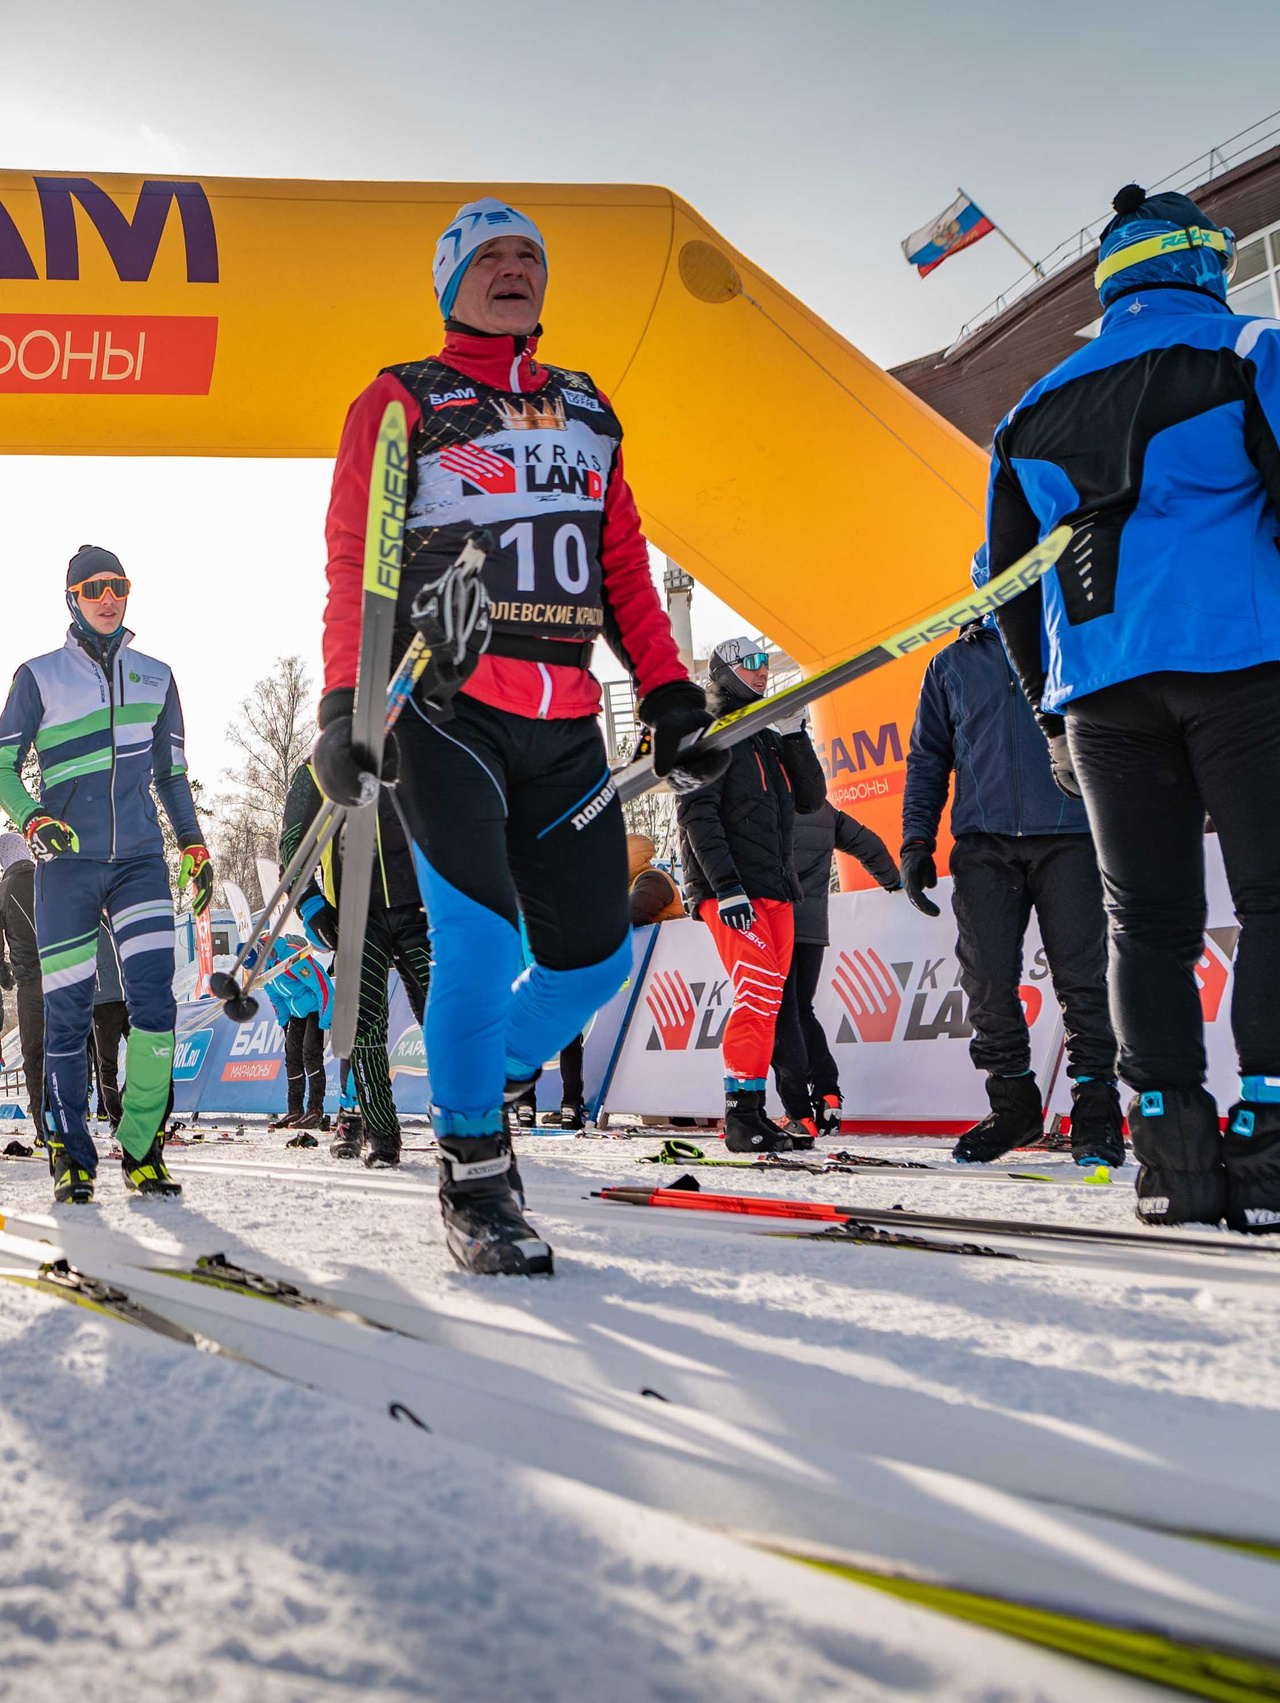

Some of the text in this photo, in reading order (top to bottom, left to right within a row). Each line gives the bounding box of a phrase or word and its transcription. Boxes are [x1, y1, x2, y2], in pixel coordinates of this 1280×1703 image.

[429, 387, 477, 405] БАМ
[525, 443, 602, 472] KRAS
[526, 464, 602, 499] LAND
[378, 438, 409, 592] FISCHER
[499, 521, 590, 594] 10
[896, 558, 1046, 654] FISCHER
[917, 948, 1050, 990] KS
[230, 1020, 287, 1056] БАМ
[230, 1064, 273, 1078] МАРАФОНЫ
